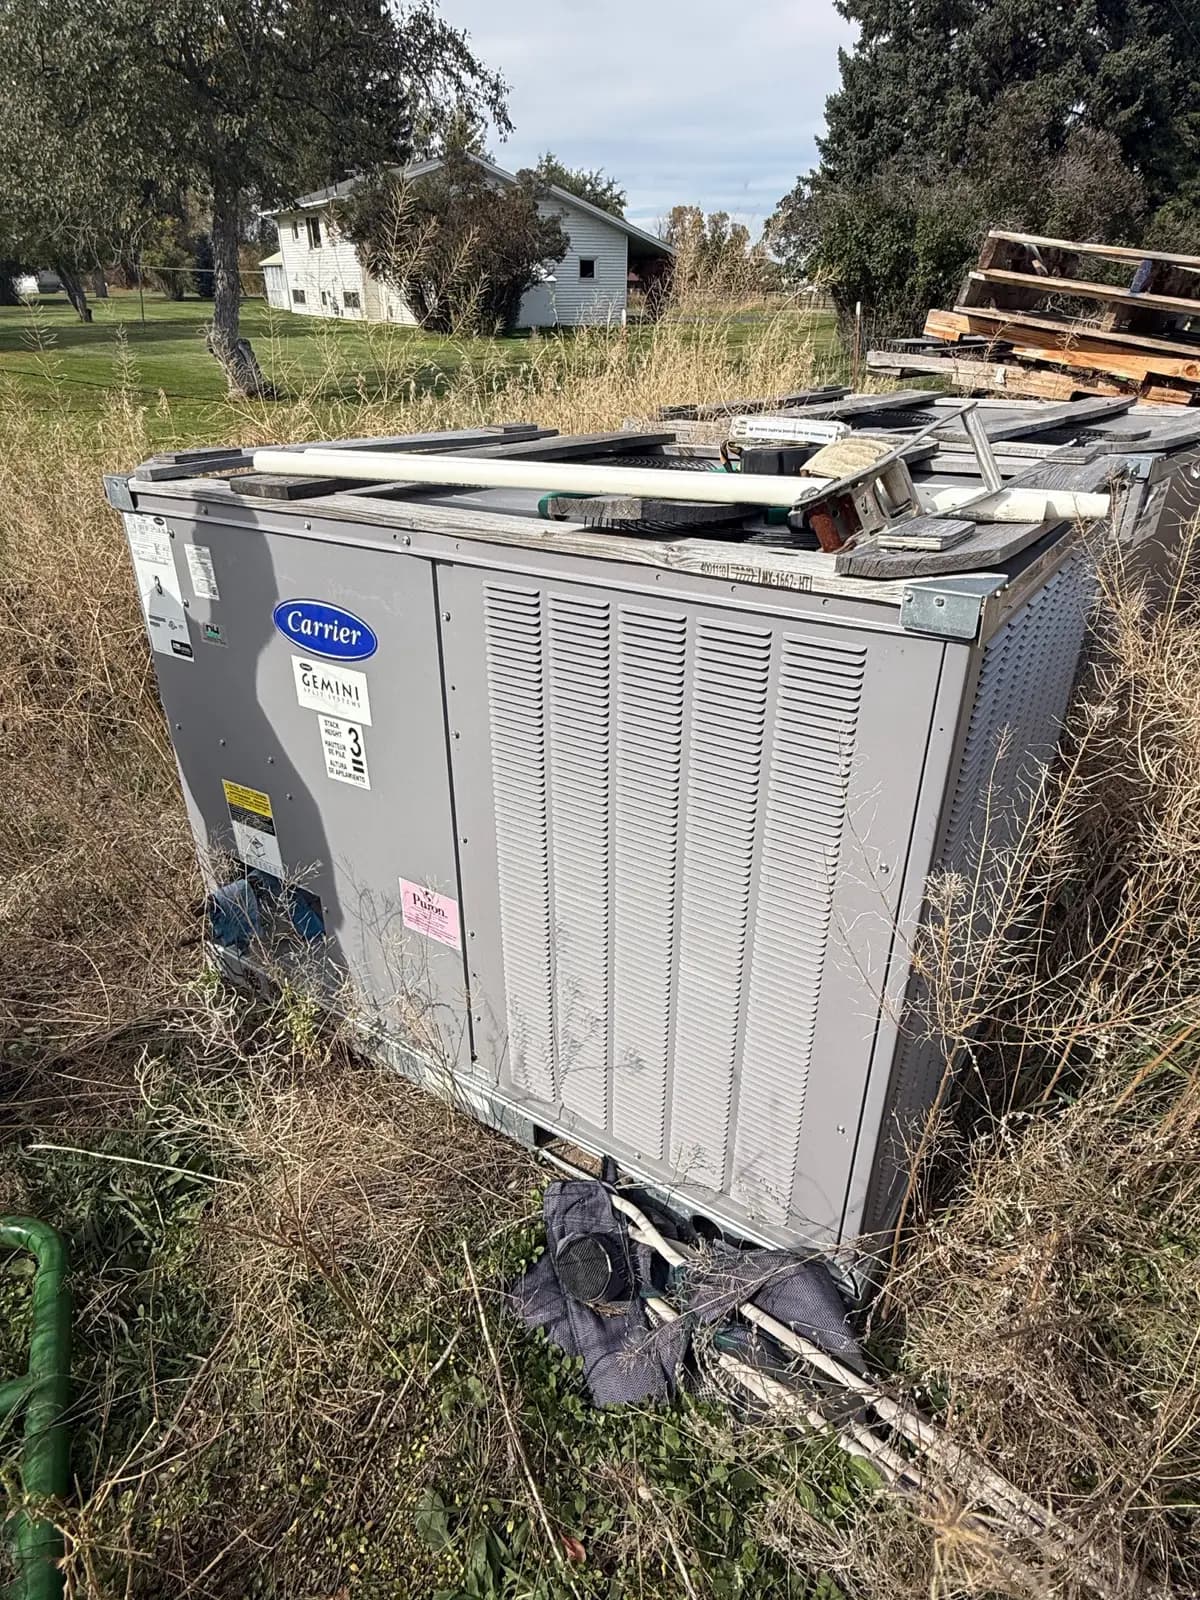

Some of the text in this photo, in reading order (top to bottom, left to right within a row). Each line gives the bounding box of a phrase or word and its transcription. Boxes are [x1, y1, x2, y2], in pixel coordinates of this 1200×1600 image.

[287, 610, 362, 645] Carrier
[302, 673, 359, 701] GEMINI
[348, 727, 362, 757] 3
